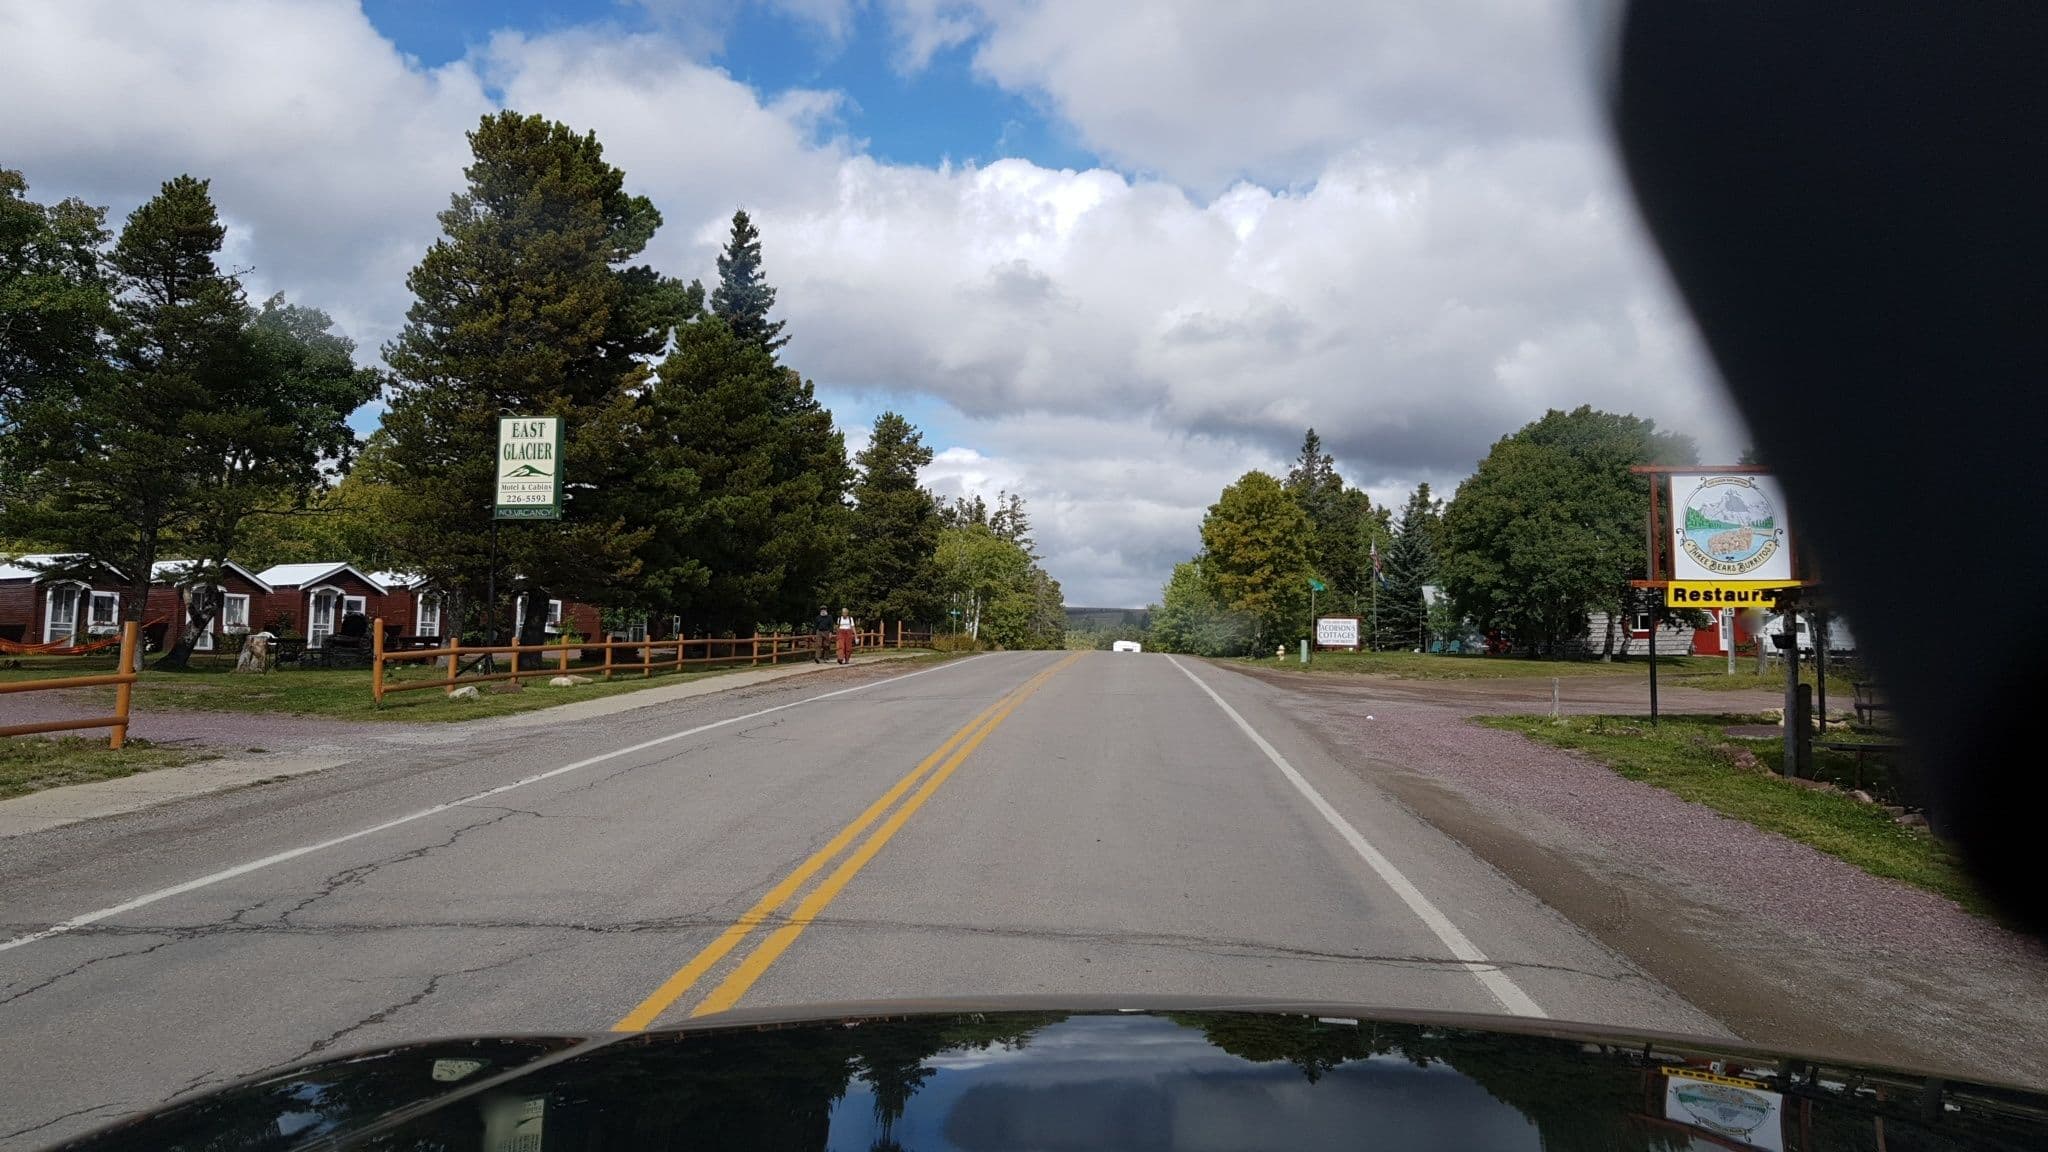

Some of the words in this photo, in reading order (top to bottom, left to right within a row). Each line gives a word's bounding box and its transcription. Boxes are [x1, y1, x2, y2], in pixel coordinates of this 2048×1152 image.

[512, 422, 545, 438] EAST
[504, 442, 552, 460] GLACIER
[528, 483, 552, 491] Cabins
[506, 495, 546, 503] 226-5593
[513, 509, 552, 517] VACANCY
[1689, 544, 1709, 565] THREE
[1709, 560, 1736, 572] BEARS
[1738, 546, 1771, 572] BURRITOS
